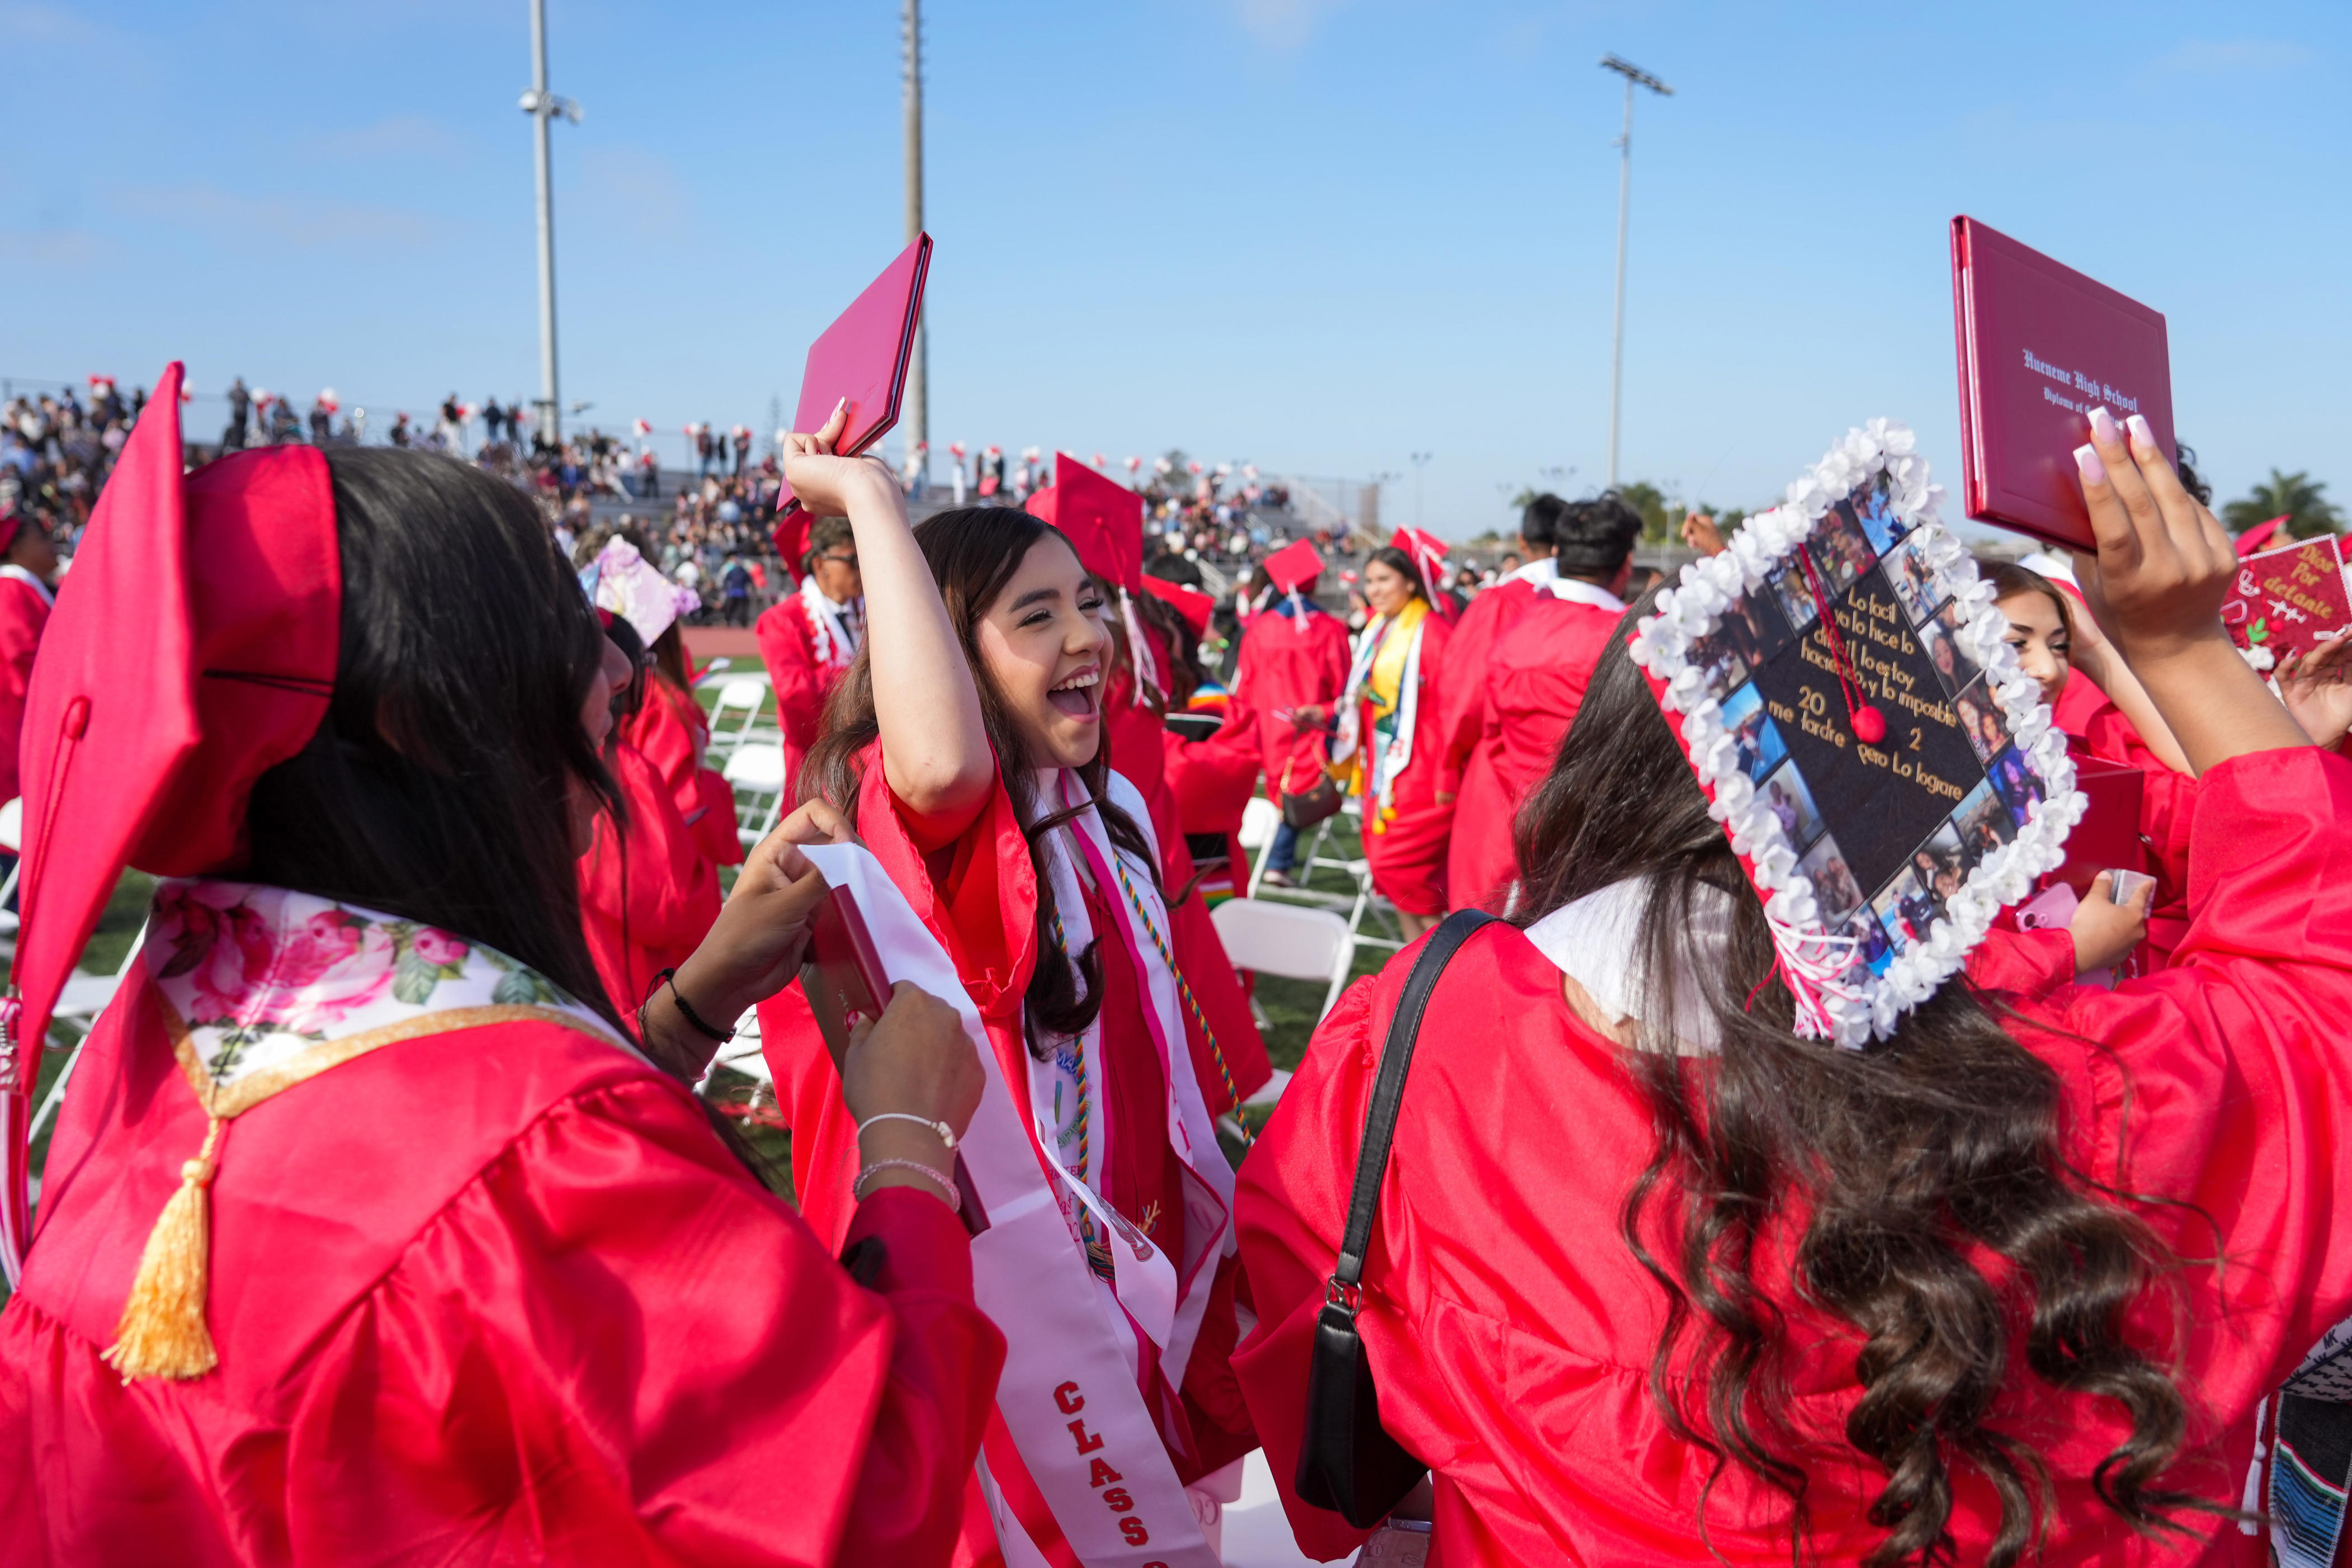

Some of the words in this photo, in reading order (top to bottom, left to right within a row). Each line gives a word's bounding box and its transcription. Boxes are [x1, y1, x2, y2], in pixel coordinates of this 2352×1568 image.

[2022, 348, 2071, 386] Hueneme
[2074, 370, 2100, 401] High
[2103, 384, 2138, 414] School
[2043, 386, 2074, 411] Diploma
[2075, 402, 2084, 414] of
[2290, 561, 2321, 587] Por
[2297, 546, 2335, 573] Dios
[1848, 585, 1868, 612] Lo
[1869, 593, 1897, 625] facil
[2264, 577, 2334, 619] delante
[1852, 610, 1867, 636] lo
[1869, 616, 1900, 650] hice
[1901, 629, 1915, 655] lo
[1860, 644, 1876, 670] lo
[1876, 660, 1916, 692] estoy
[1797, 684, 1827, 716] 20
[1909, 727, 1923, 752] 2
[1882, 676, 1897, 701] lo
[1898, 690, 1958, 728] imposible
[1768, 699, 1796, 724] me
[1800, 709, 1846, 749] tardre
[1857, 743, 1890, 768] pero
[1892, 750, 1913, 778] Lo
[1915, 761, 1964, 801] lograre
[1053, 1380, 1150, 1547] CLASS
